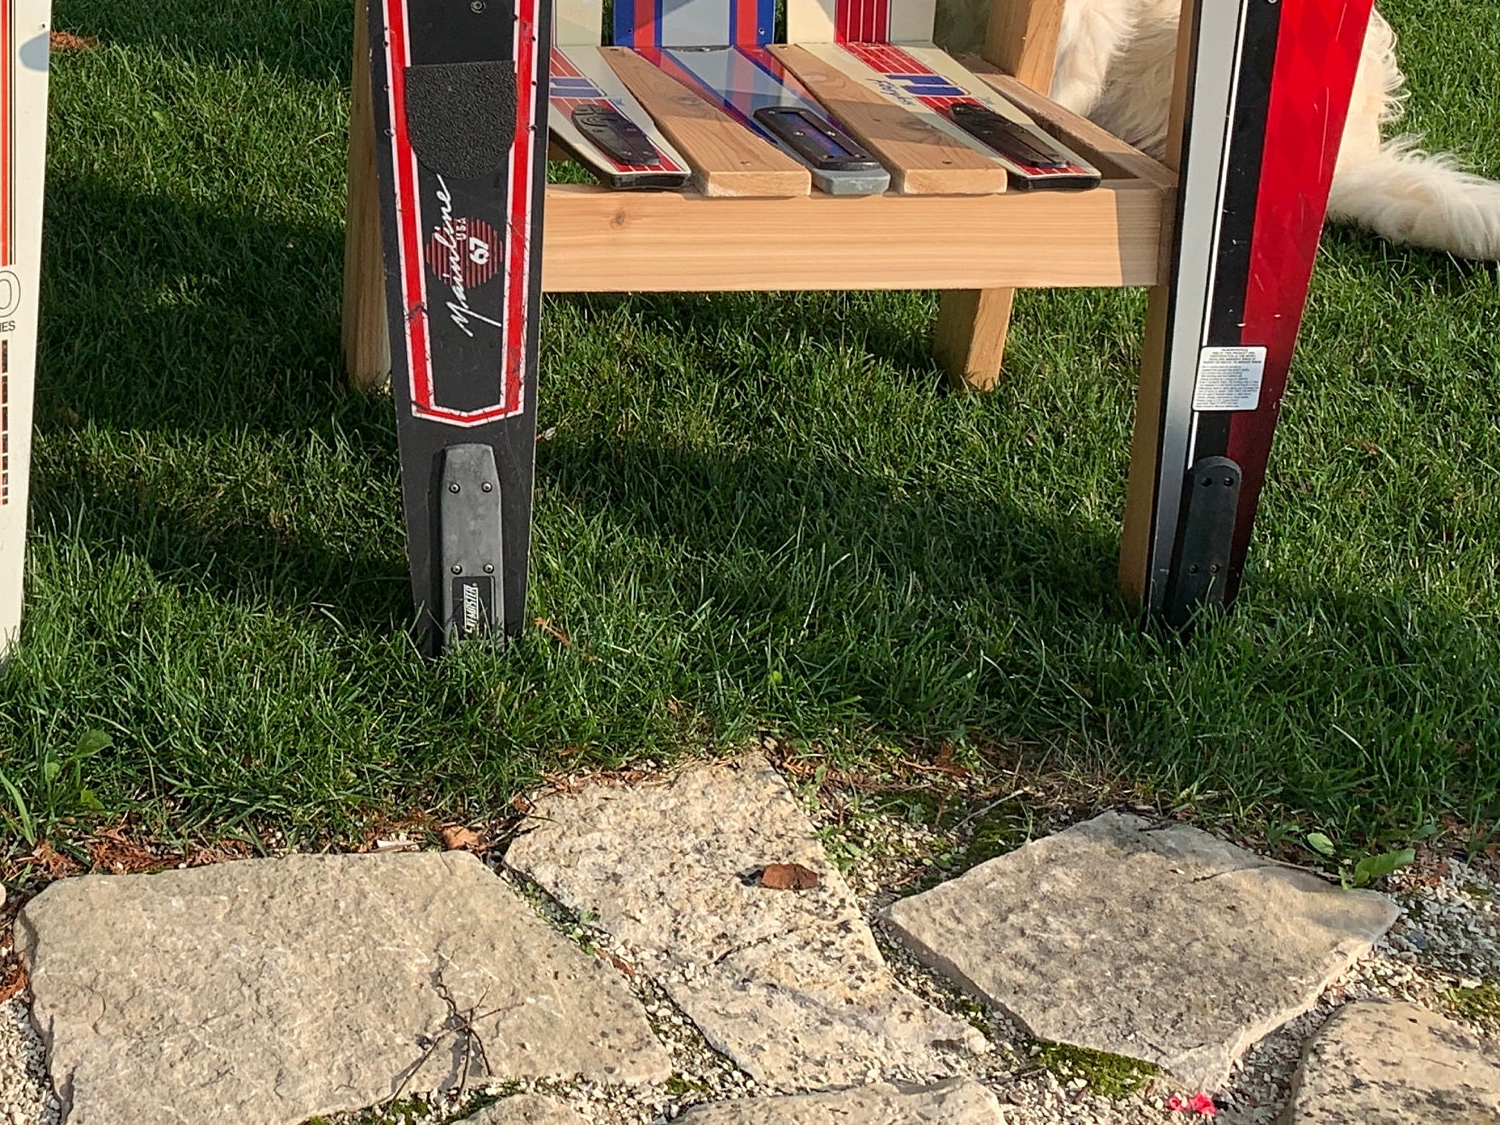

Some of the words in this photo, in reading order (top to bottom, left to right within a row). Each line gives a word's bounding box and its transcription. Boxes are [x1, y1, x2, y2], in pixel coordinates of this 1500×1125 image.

[456, 217, 467, 241] USA
[436, 174, 502, 337] Mainline
[469, 236, 490, 266] 67
